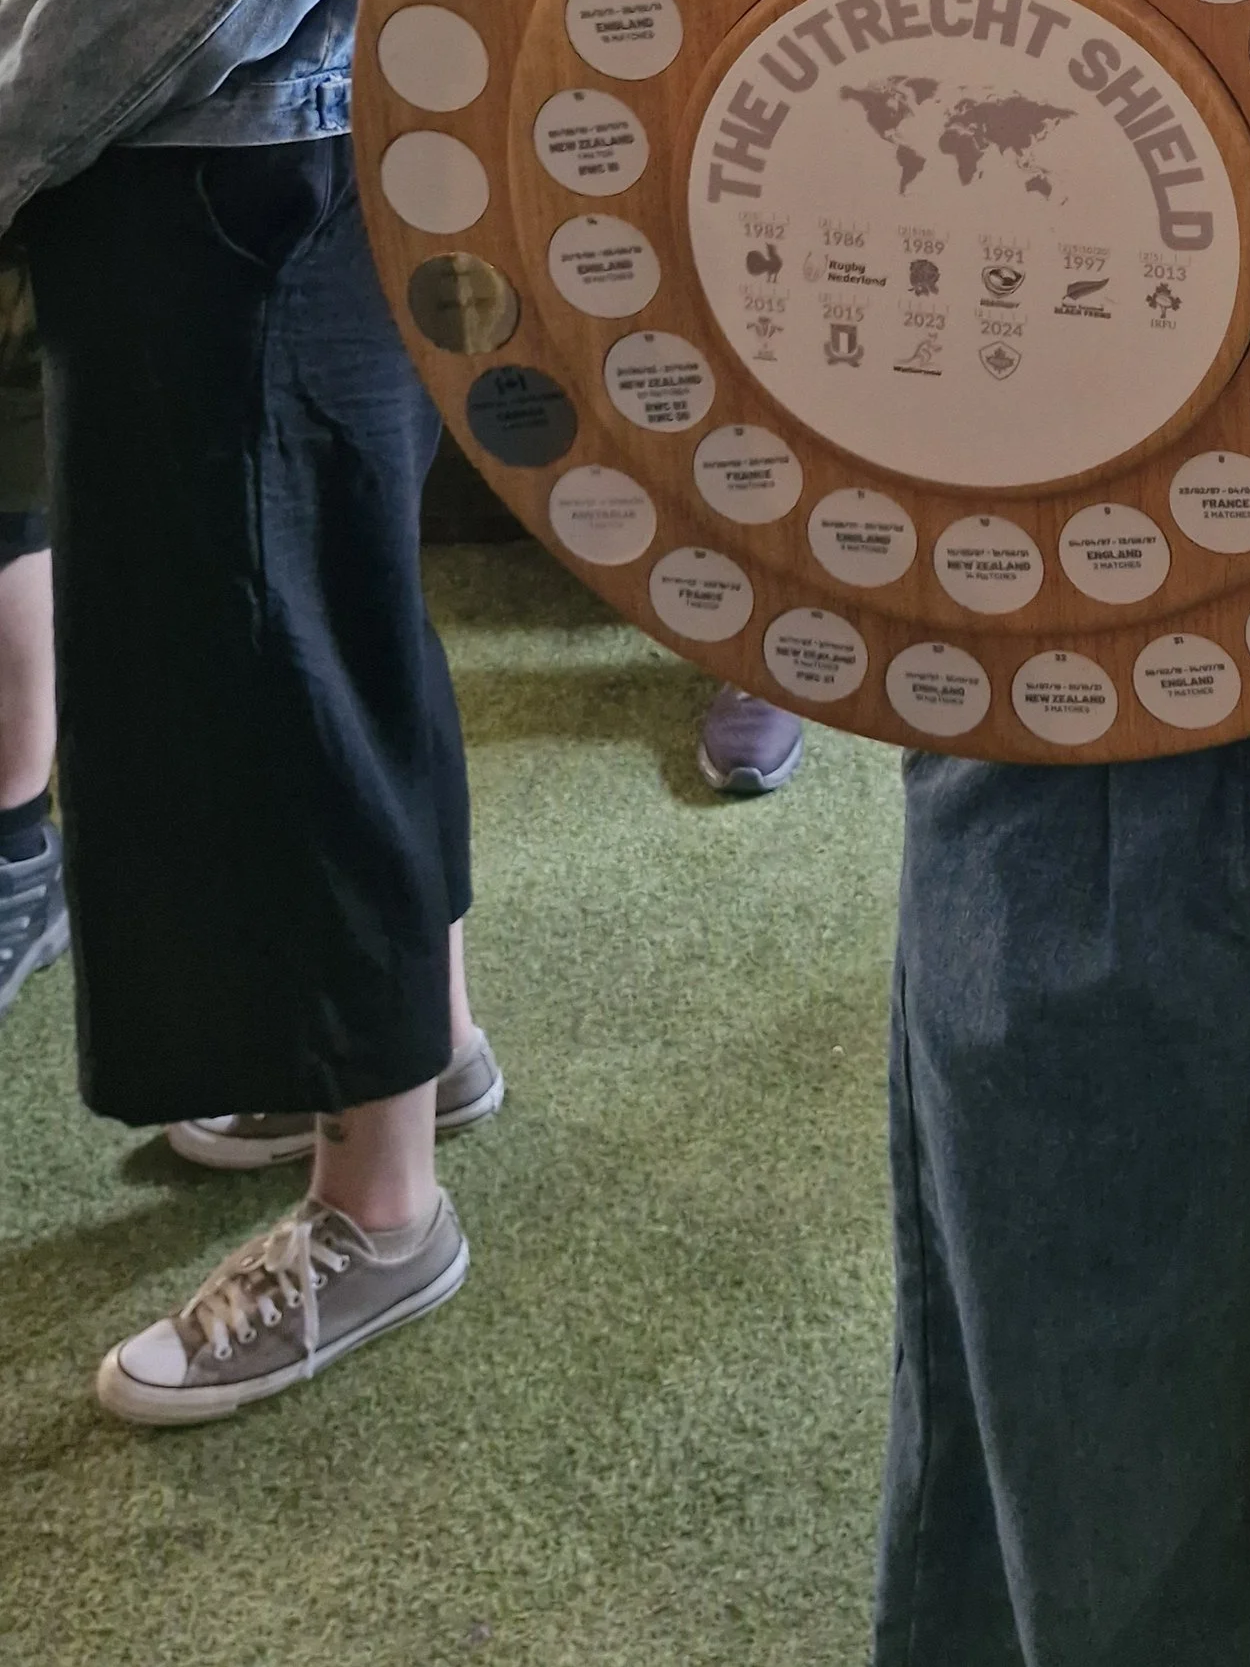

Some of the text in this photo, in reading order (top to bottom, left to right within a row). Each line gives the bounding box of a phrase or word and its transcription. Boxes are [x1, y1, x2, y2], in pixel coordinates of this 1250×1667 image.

[707, 80, 791, 202] THE
[1067, 38, 1213, 251] SHIELD
[744, 223, 785, 239] 1982
[823, 230, 865, 248] 1986
[903, 239, 945, 255] 1989
[983, 247, 1024, 264] 1991
[829, 260, 866, 274] Rugby
[1064, 256, 1106, 272] 1997
[827, 273, 886, 287] Nederland
[1144, 264, 1187, 281] 2013
[744, 296, 785, 313] 2015
[823, 304, 865, 322] 2015
[904, 312, 945, 330] 2023
[981, 321, 1023, 337] 2024
[1150, 319, 1177, 331] IRFU
[1202, 499, 1250, 508] FRANCE
[1087, 550, 1142, 560] ENGLAND
[948, 561, 1030, 571] NEW ZEALAND
[1100, 561, 1141, 570] MATCHES
[1161, 676, 1213, 688] ENGLAND
[1025, 695, 1105, 704] NEW ZEALAND
